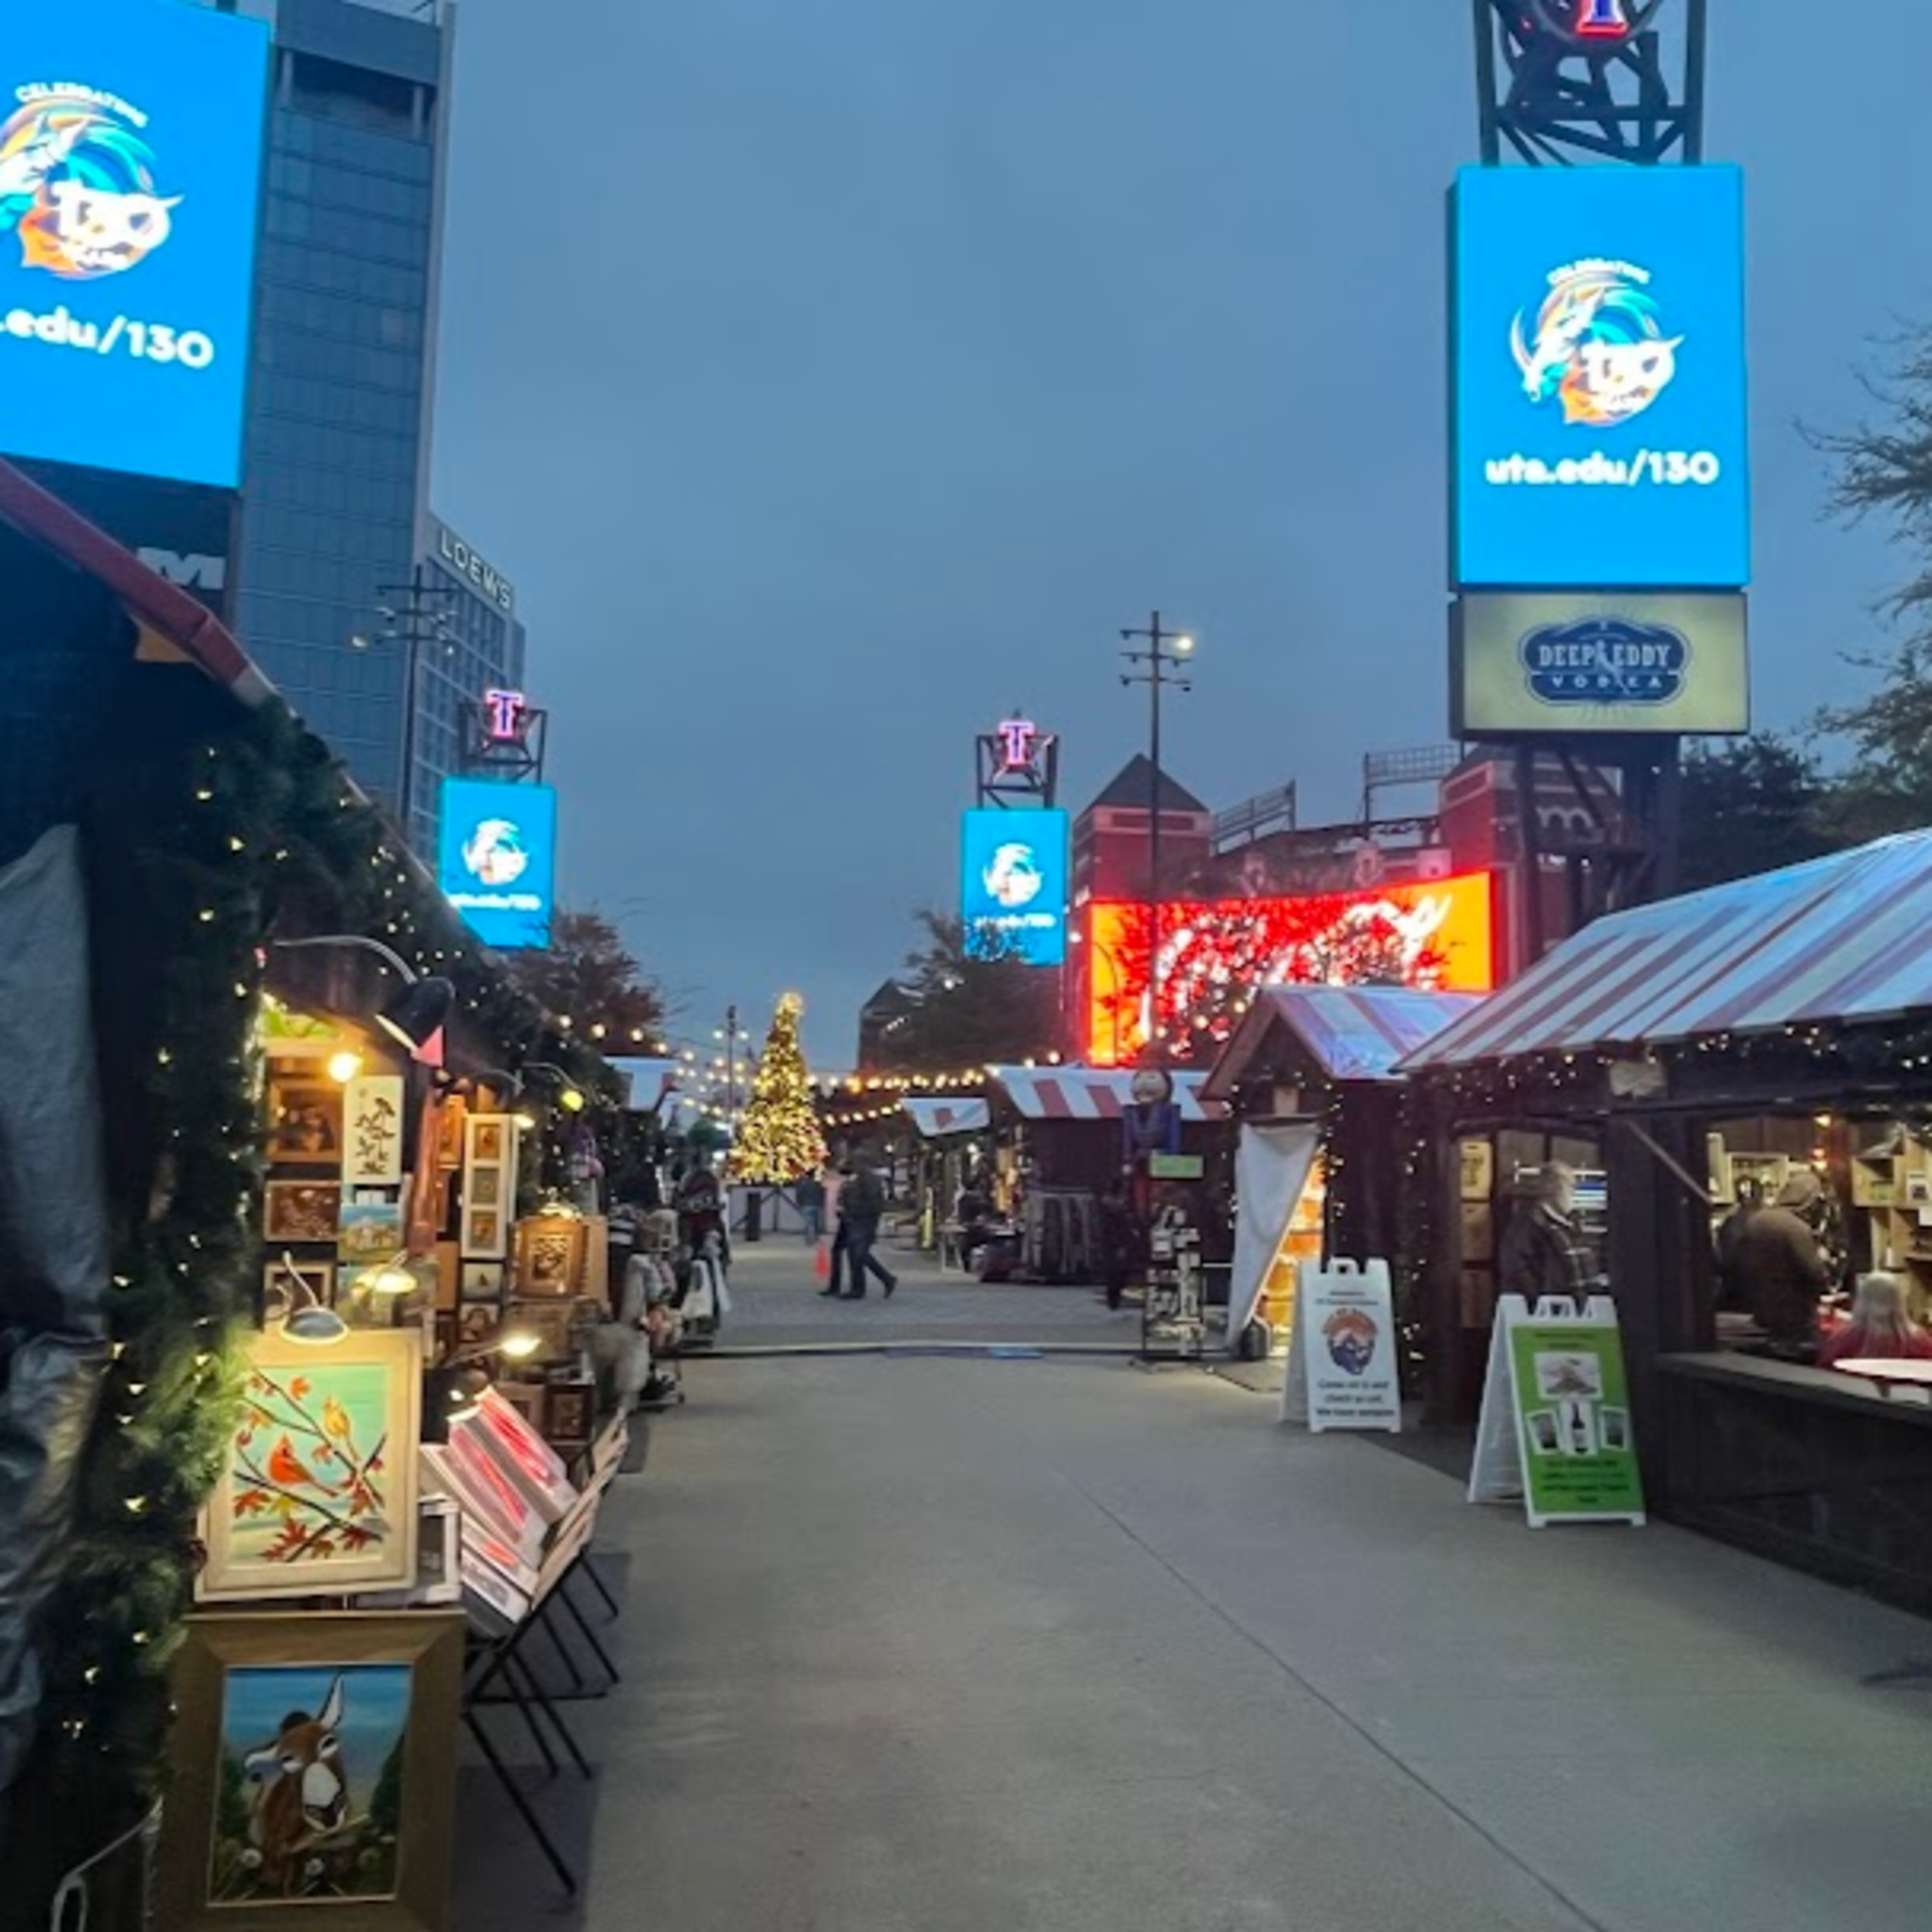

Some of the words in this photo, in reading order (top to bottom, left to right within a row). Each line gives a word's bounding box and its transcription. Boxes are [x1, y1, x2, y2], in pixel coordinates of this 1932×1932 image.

[1485, 450, 1719, 484] uta.edu/130
[440, 528, 511, 609] LOEWS
[1539, 645, 1595, 666] DEEP
[1613, 645, 1671, 666] EDDY
[1552, 675, 1662, 688] VODKA
